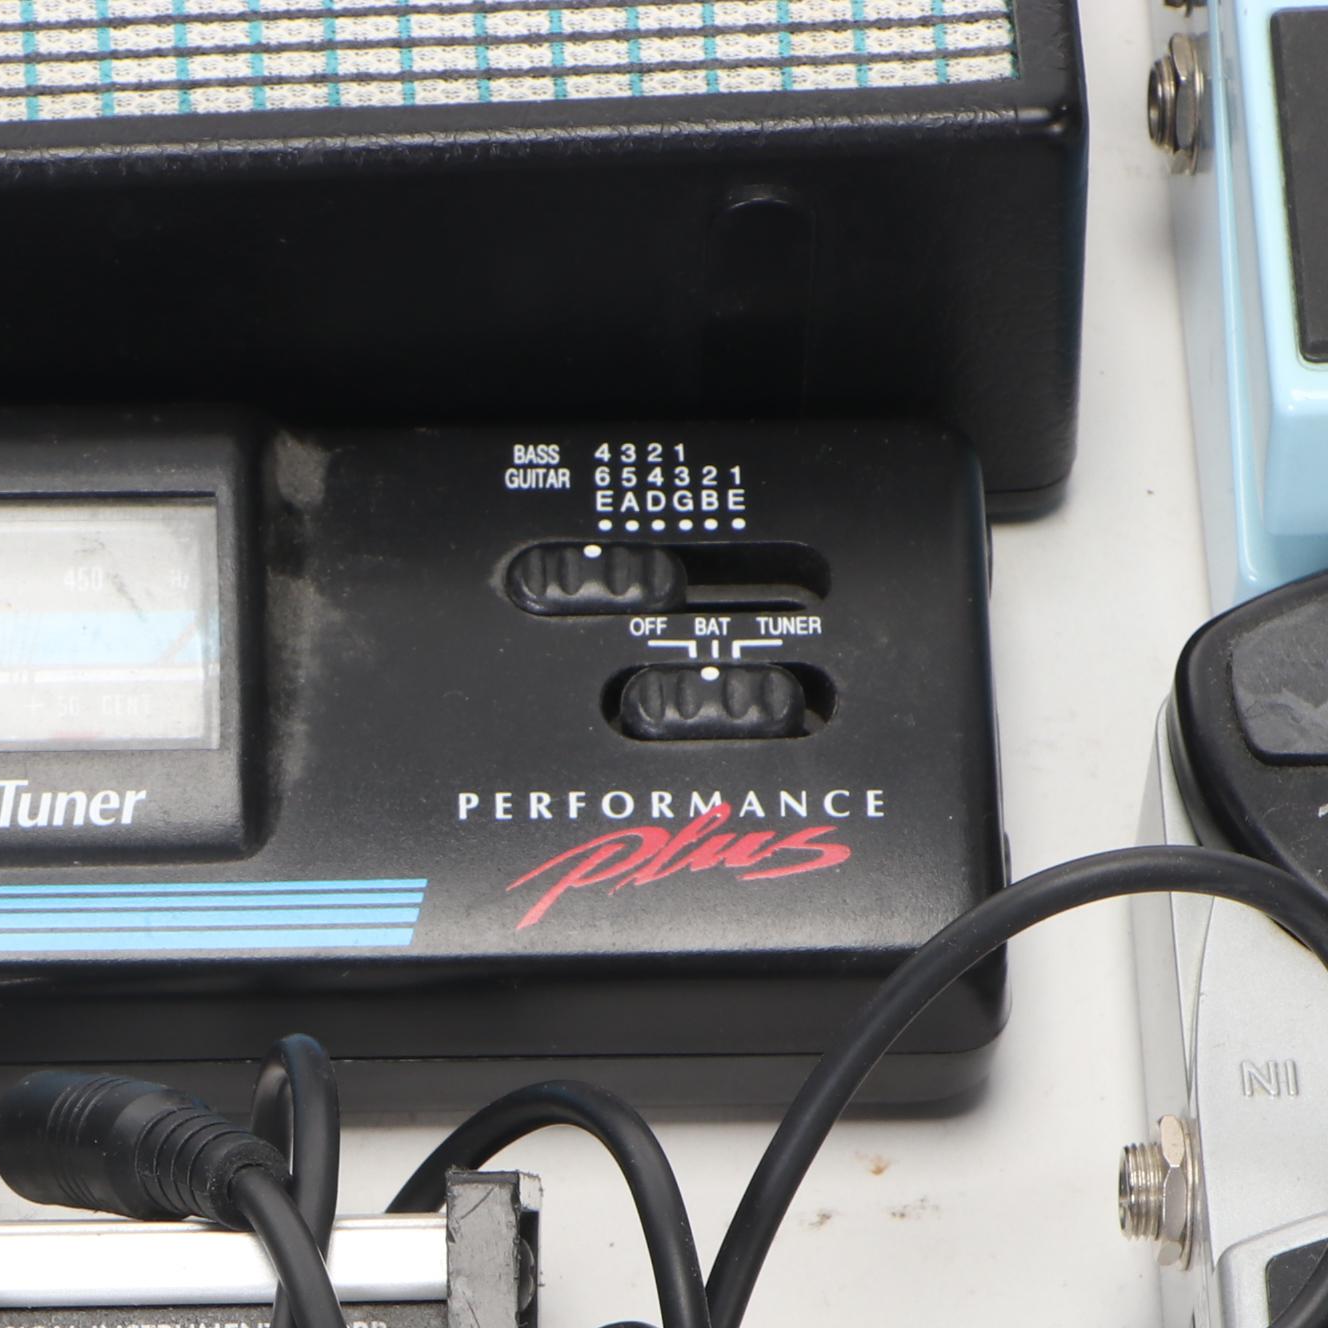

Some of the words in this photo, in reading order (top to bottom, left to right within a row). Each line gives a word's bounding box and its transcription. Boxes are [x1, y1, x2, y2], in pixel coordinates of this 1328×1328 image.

[513, 444, 560, 465] BASS
[504, 468, 571, 489] GUITAR
[63, 565, 103, 591] 450
[629, 616, 668, 637] OFF
[694, 617, 731, 636] BAT
[755, 616, 822, 636] TUNER
[458, 789, 885, 820] PERFORMANCE
